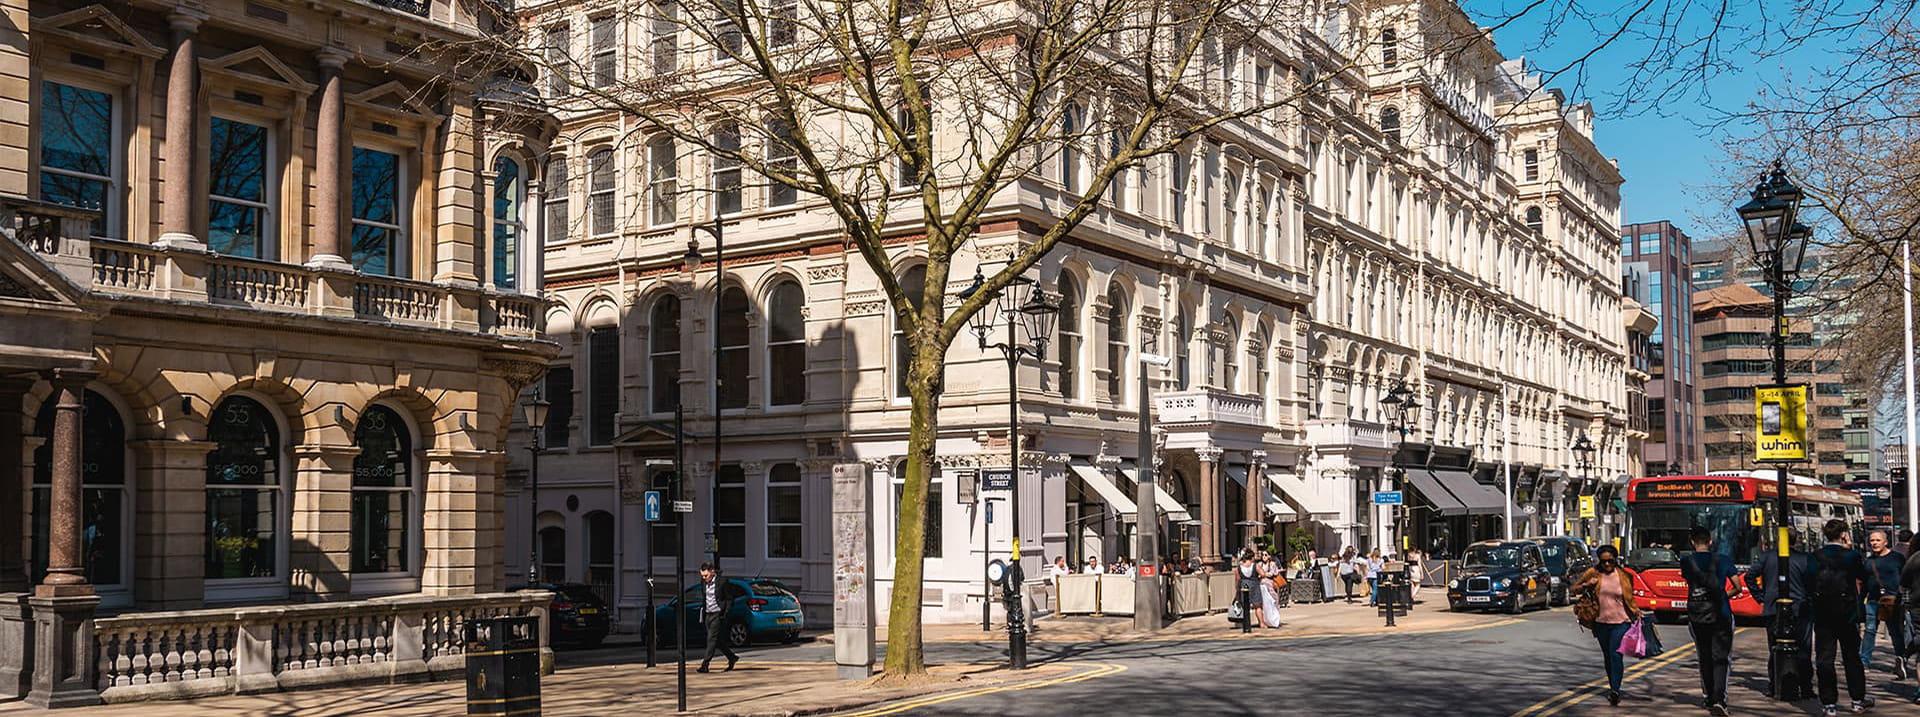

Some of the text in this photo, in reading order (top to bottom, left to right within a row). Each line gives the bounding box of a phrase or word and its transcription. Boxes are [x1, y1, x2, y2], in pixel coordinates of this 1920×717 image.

[224, 404, 248, 424] 55
[1761, 438, 1803, 450] whim
[1702, 483, 1731, 498] 120A
